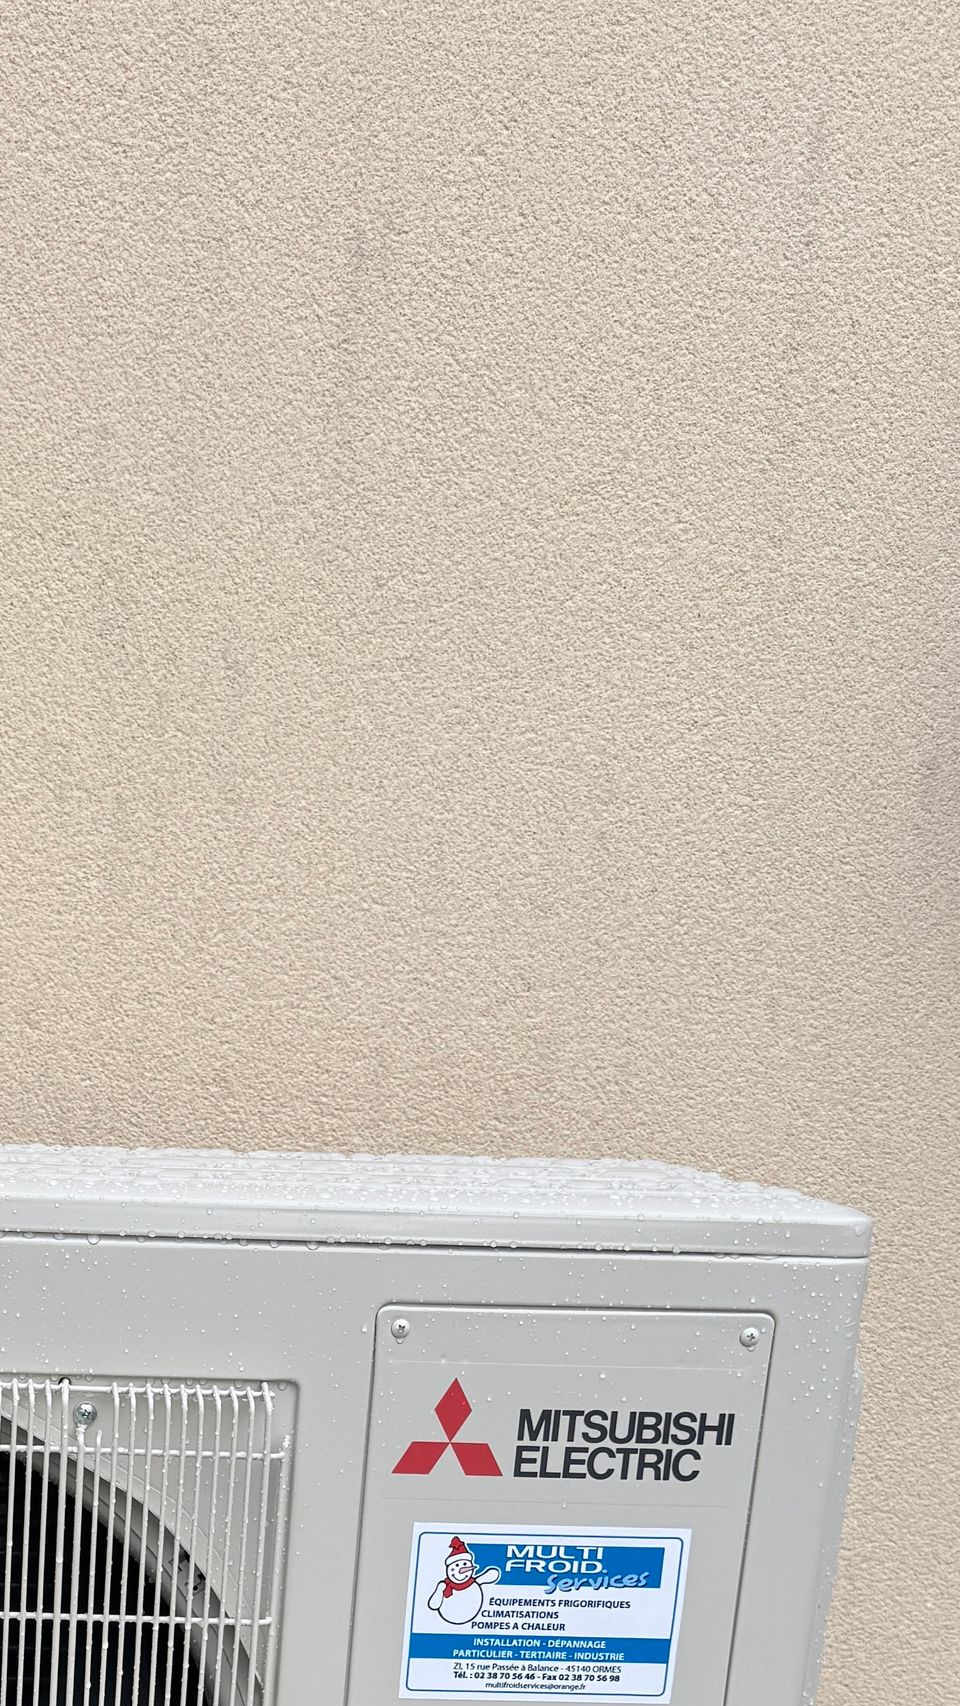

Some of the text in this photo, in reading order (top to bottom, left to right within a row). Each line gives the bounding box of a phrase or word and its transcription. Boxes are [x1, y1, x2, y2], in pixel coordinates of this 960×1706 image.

[517, 1408, 735, 1446] MITSUBISHI
[513, 1446, 701, 1482] ELECTRIC
[506, 1545, 604, 1560] MULTI
[504, 1559, 604, 1574] FROID
[488, 1597, 631, 1609] ÉQUIPEMENTS FRIGORIFIQUES
[481, 1609, 559, 1619] CLIMATISATIONS
[471, 1621, 566, 1632] POMPES A CHALEUR
[473, 1638, 540, 1648] INSTALLATION
[548, 1639, 606, 1649] DÉPANNAGE
[452, 1649, 513, 1659] PARTICULIER
[520, 1651, 567, 1660] TERTIAIRE
[574, 1652, 625, 1661] INDUSTRIE
[466, 1663, 475, 1671] 15
[492, 1663, 519, 1672] Passée
[527, 1664, 559, 1673] Balance
[565, 1665, 591, 1674] 45140
[592, 1666, 622, 1674] ORMES
[486, 1672, 498, 1680] 38
[499, 1672, 511, 1680] 70
[542, 1673, 557, 1681] Fax
[571, 1674, 582, 1682] 38
[583, 1674, 595, 1682] 70
[596, 1674, 608, 1682] 56
[485, 1681, 587, 1691] multifroidservices@orange.fr
